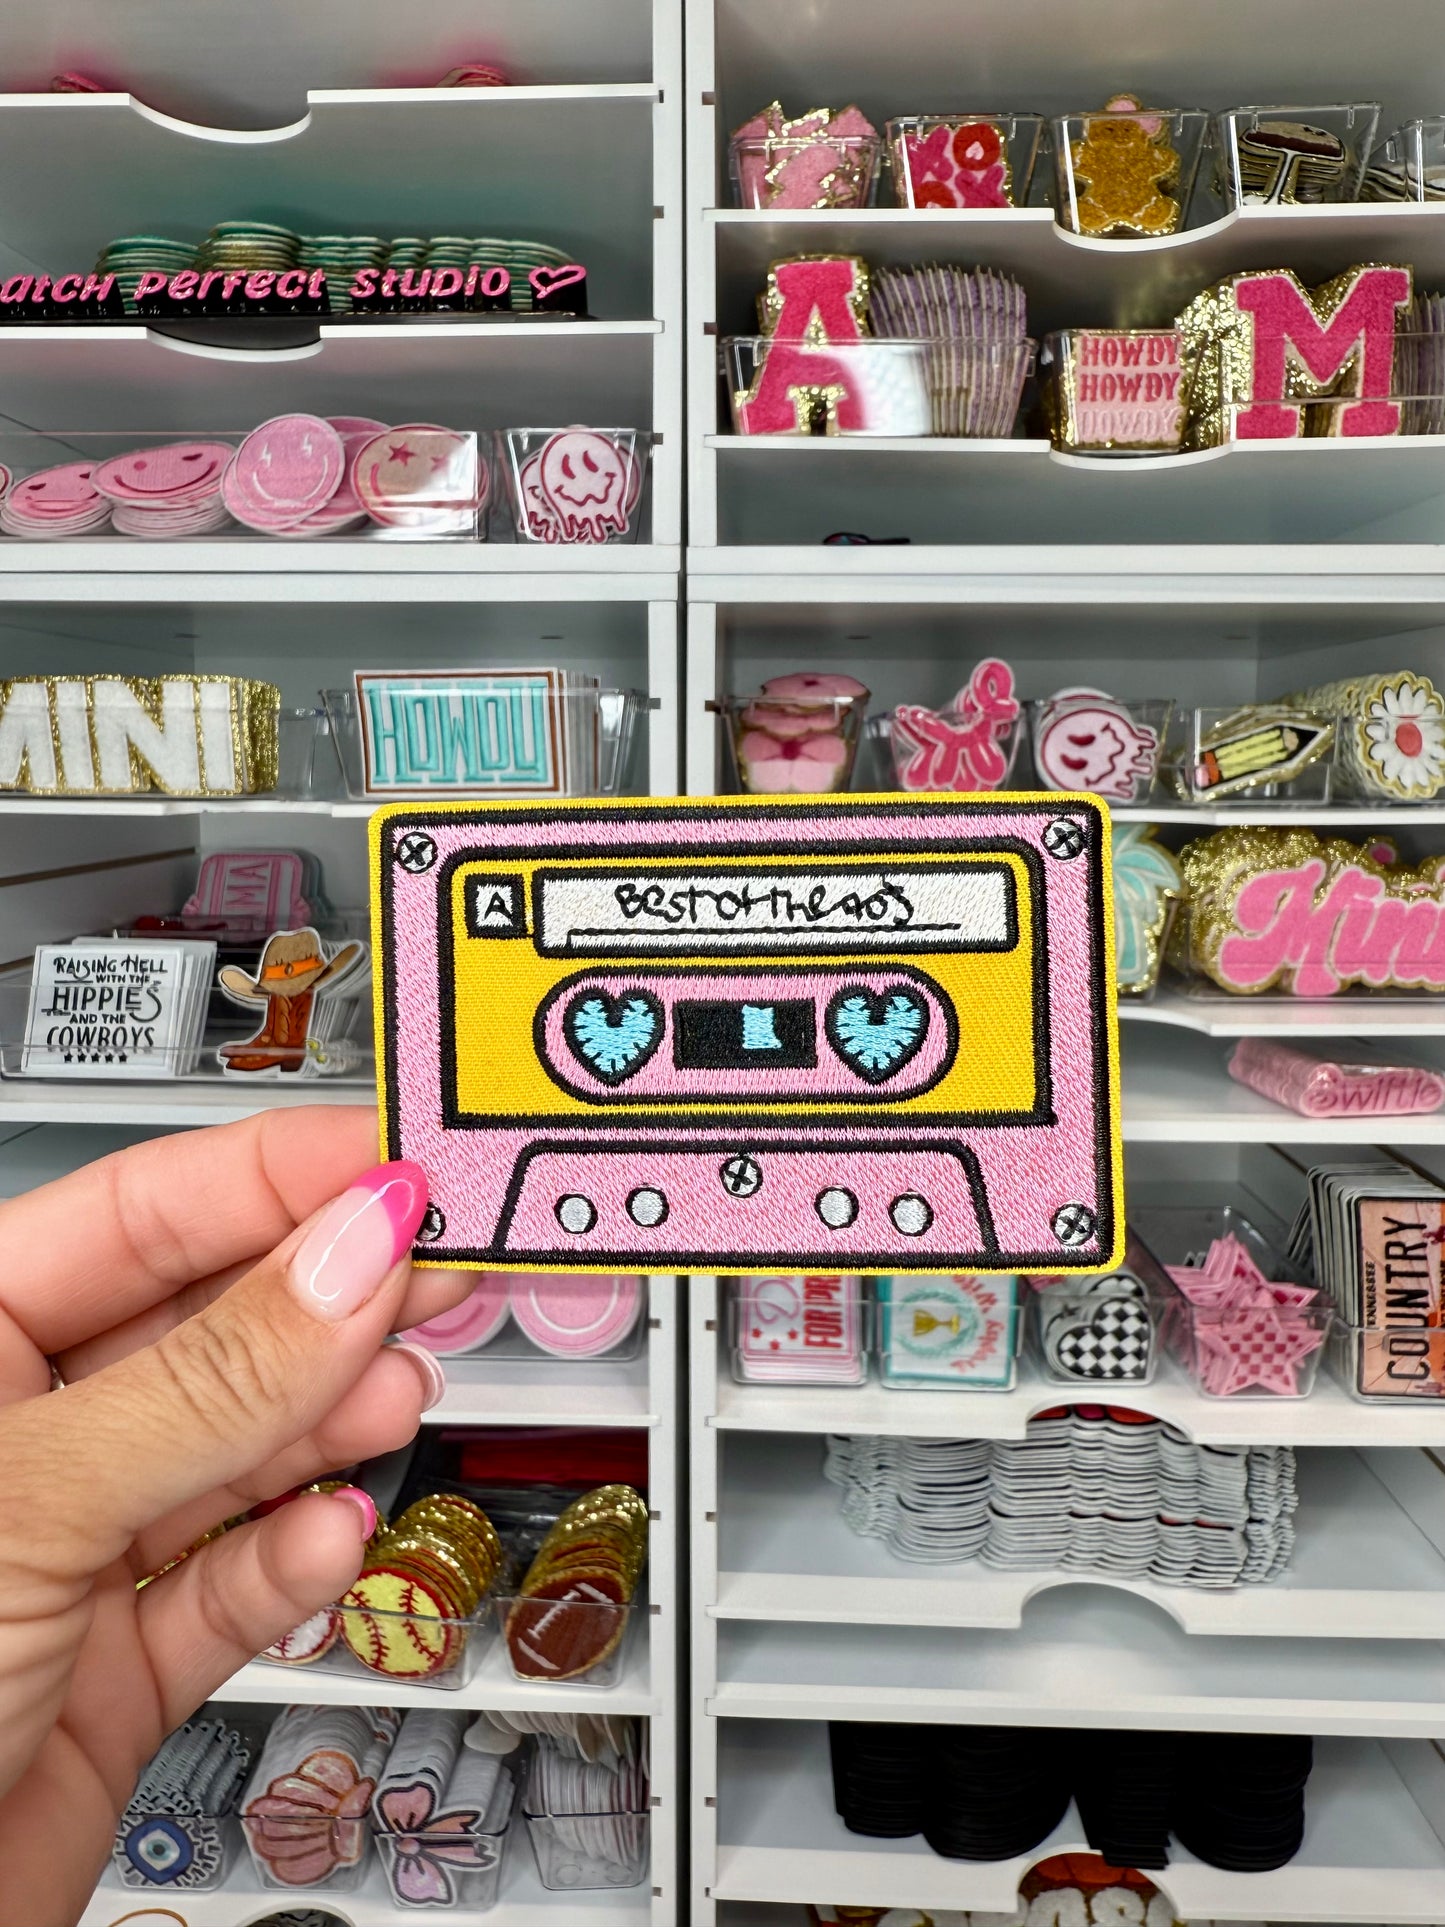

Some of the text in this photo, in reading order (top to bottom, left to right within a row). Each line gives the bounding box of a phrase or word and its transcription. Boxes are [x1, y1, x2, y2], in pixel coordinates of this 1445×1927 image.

[1080, 336, 1181, 367] HOWDY
[1234, 268, 1410, 439] M
[1080, 372, 1180, 402] HOWDY
[362, 679, 549, 784] HOWDY
[484, 891, 514, 921] A
[53, 954, 168, 981] RAISING HELL
[96, 974, 150, 985] WITH THE
[50, 984, 162, 1023] HIPPIES
[69, 1013, 126, 1025] AND THE
[46, 1026, 155, 1053] COWBOYS
[1365, 1261, 1377, 1328] ENNESSEE
[1382, 1216, 1430, 1380] COUNTRY
[803, 1309, 843, 1348] FOR
